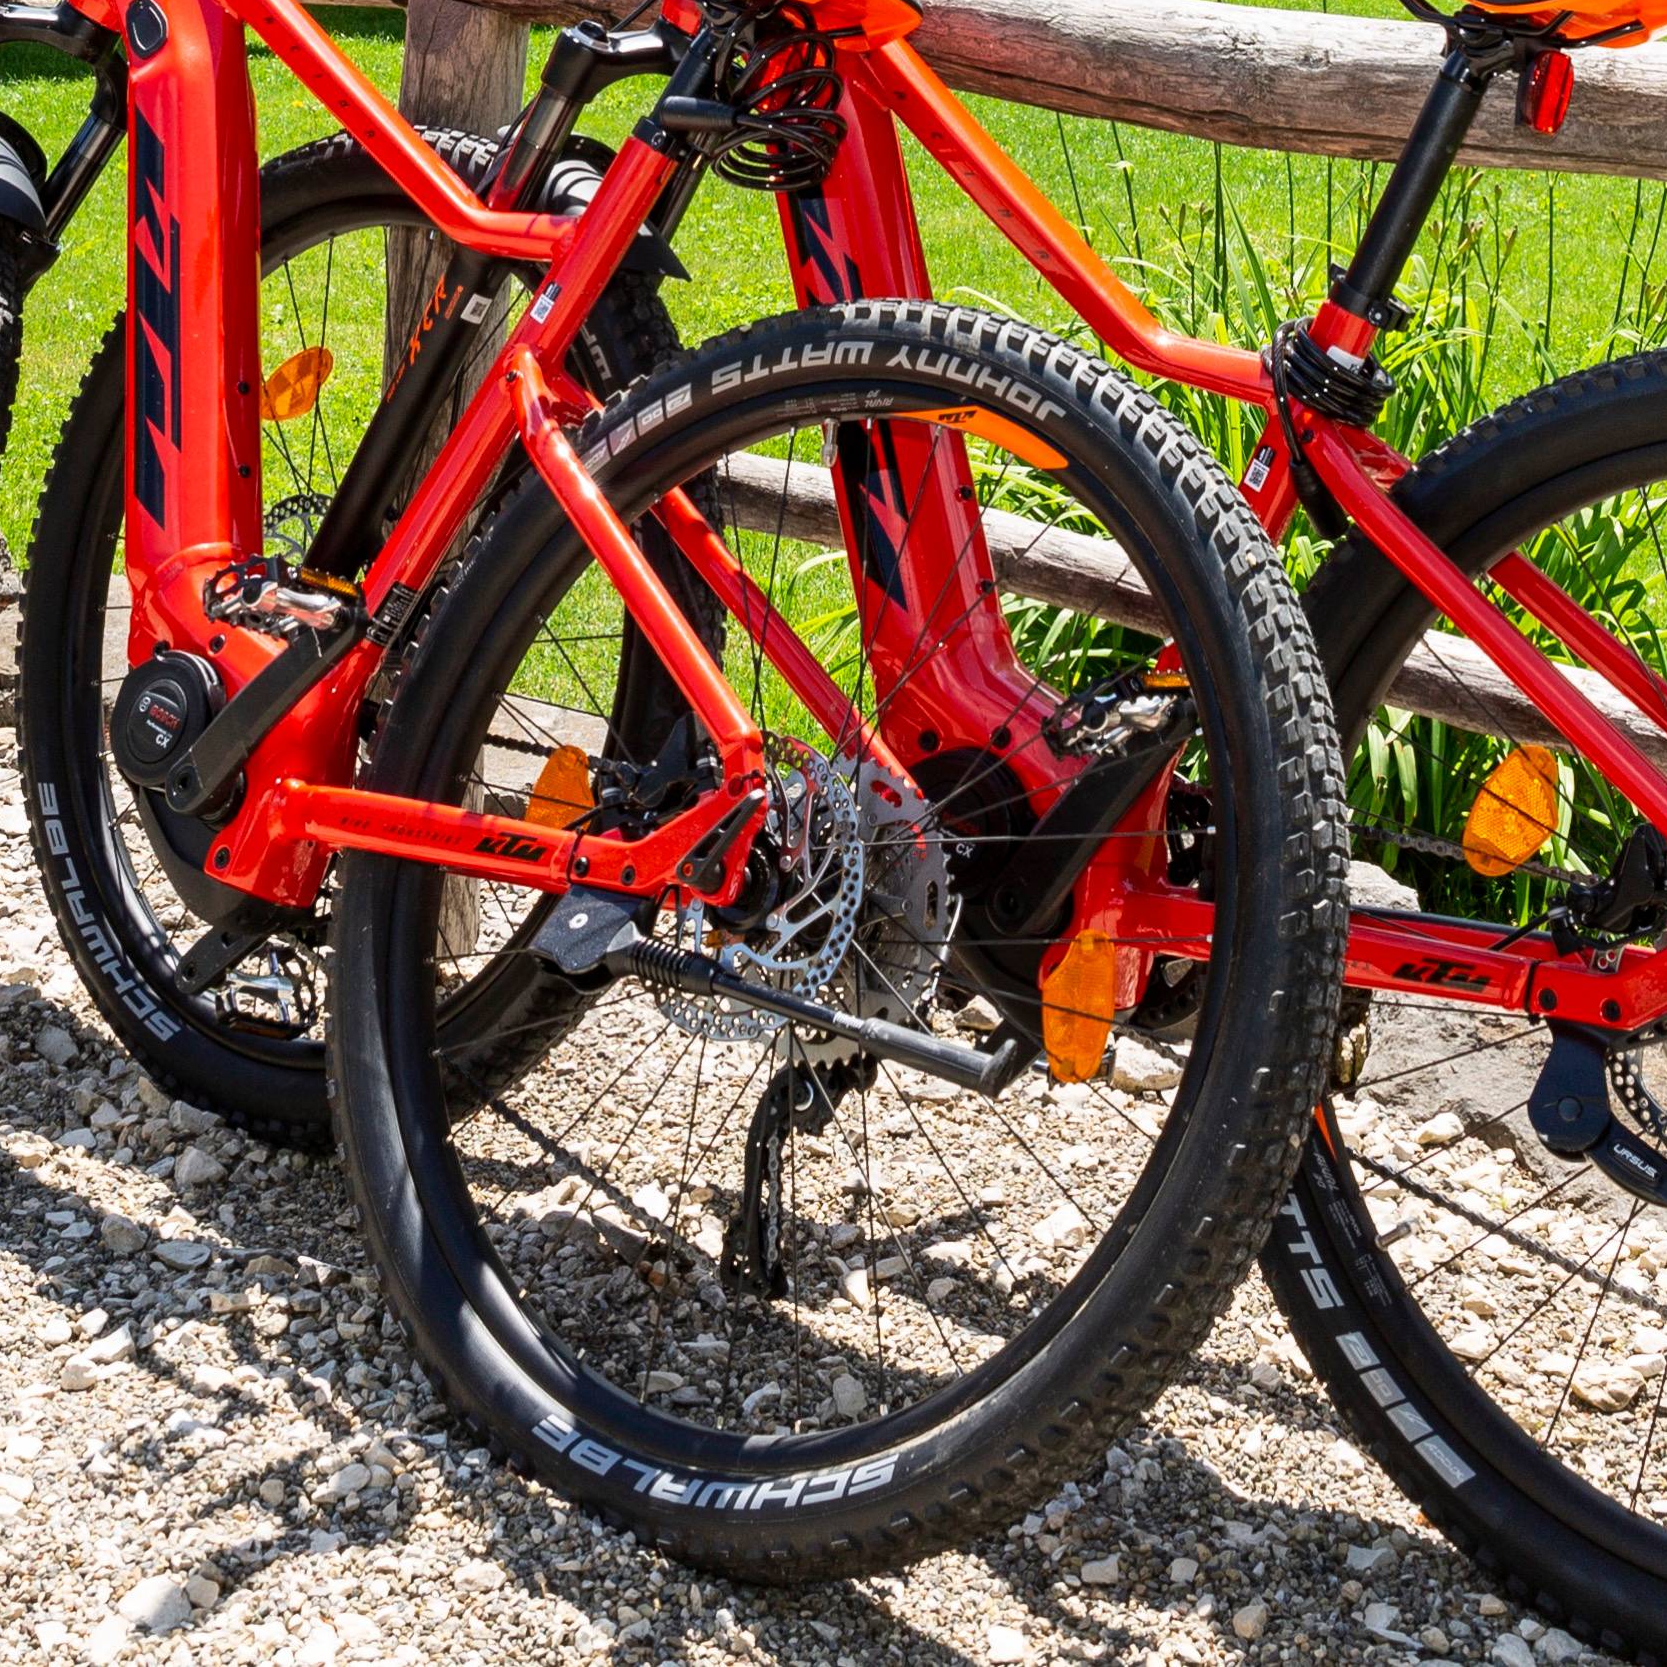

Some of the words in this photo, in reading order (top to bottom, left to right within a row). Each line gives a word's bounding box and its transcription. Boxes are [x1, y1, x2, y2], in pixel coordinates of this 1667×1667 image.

[711, 340, 875, 395] WATTS
[886, 345, 1068, 423] JOHNNY
[155, 734, 170, 749] CX
[474, 831, 547, 862] KTM
[955, 842, 974, 859] CX
[38, 782, 181, 1042] SCHWALBE
[1392, 958, 1491, 993] KTM
[1613, 1143, 1658, 1179] URSUS
[1279, 1180, 1345, 1310] TTS
[531, 1414, 900, 1510] SCHWALBE
